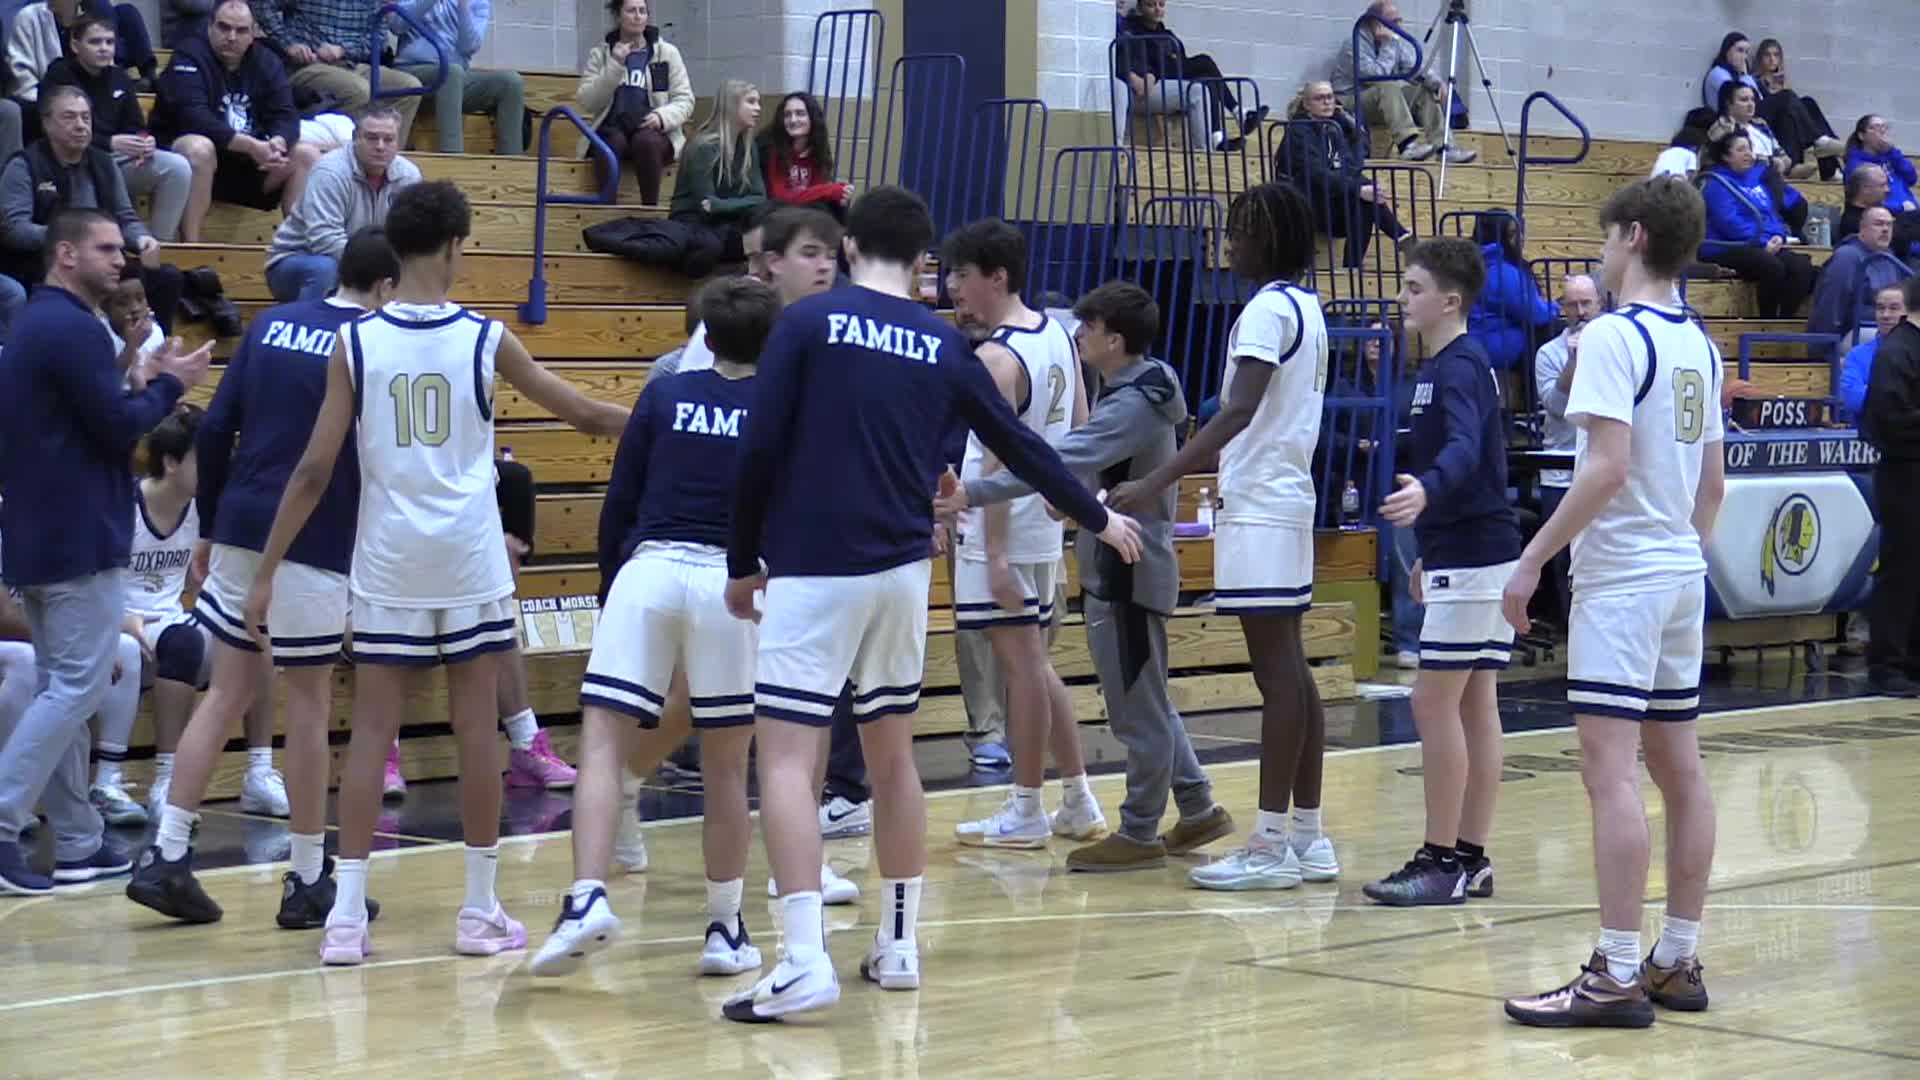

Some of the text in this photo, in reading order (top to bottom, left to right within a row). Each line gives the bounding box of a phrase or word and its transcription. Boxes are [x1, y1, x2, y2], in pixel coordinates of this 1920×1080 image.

[827, 313, 942, 364] FAMILY
[389, 373, 451, 447] 10
[1045, 363, 1066, 426] 2
[1672, 367, 1704, 444] 13
[1760, 400, 1807, 426] POSS.
[672, 402, 748, 437] FAM
[1727, 442, 1756, 468] OF
[1766, 441, 1808, 466] THE
[521, 595, 599, 612] COACH MORSE
